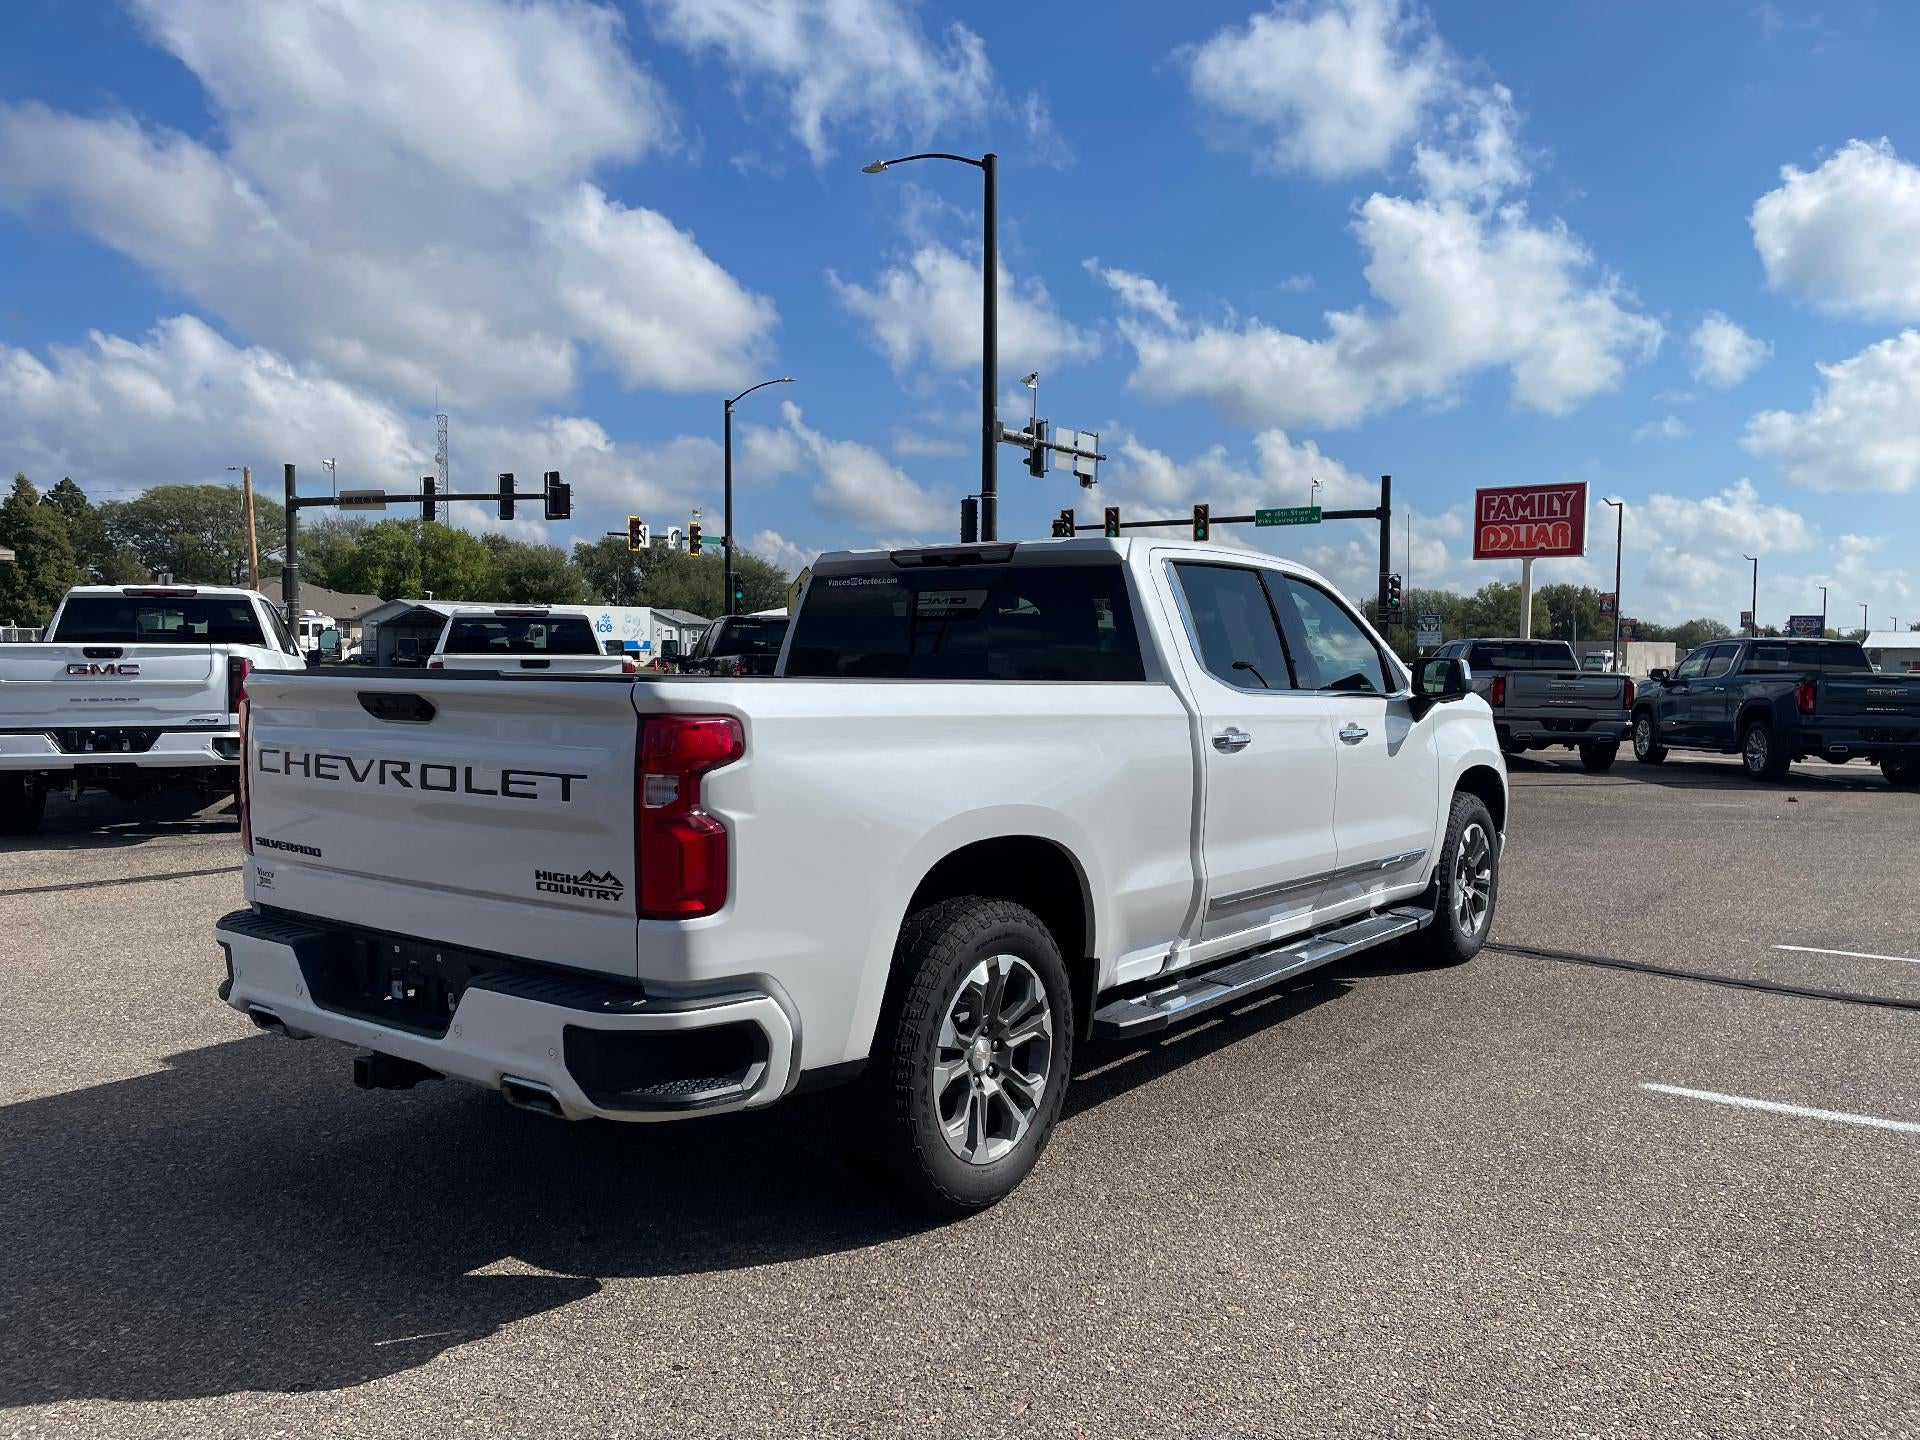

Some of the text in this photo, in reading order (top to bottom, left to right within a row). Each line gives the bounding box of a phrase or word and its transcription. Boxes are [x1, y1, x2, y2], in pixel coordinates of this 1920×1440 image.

[1482, 490, 1577, 521] FAMILY
[1480, 521, 1572, 551] DOLLAR
[66, 662, 141, 676] GMC
[259, 748, 588, 803] CHEVROLET
[255, 836, 322, 858] SILVERADO
[535, 869, 579, 885] HIGH
[535, 881, 624, 902] COUNTRY
